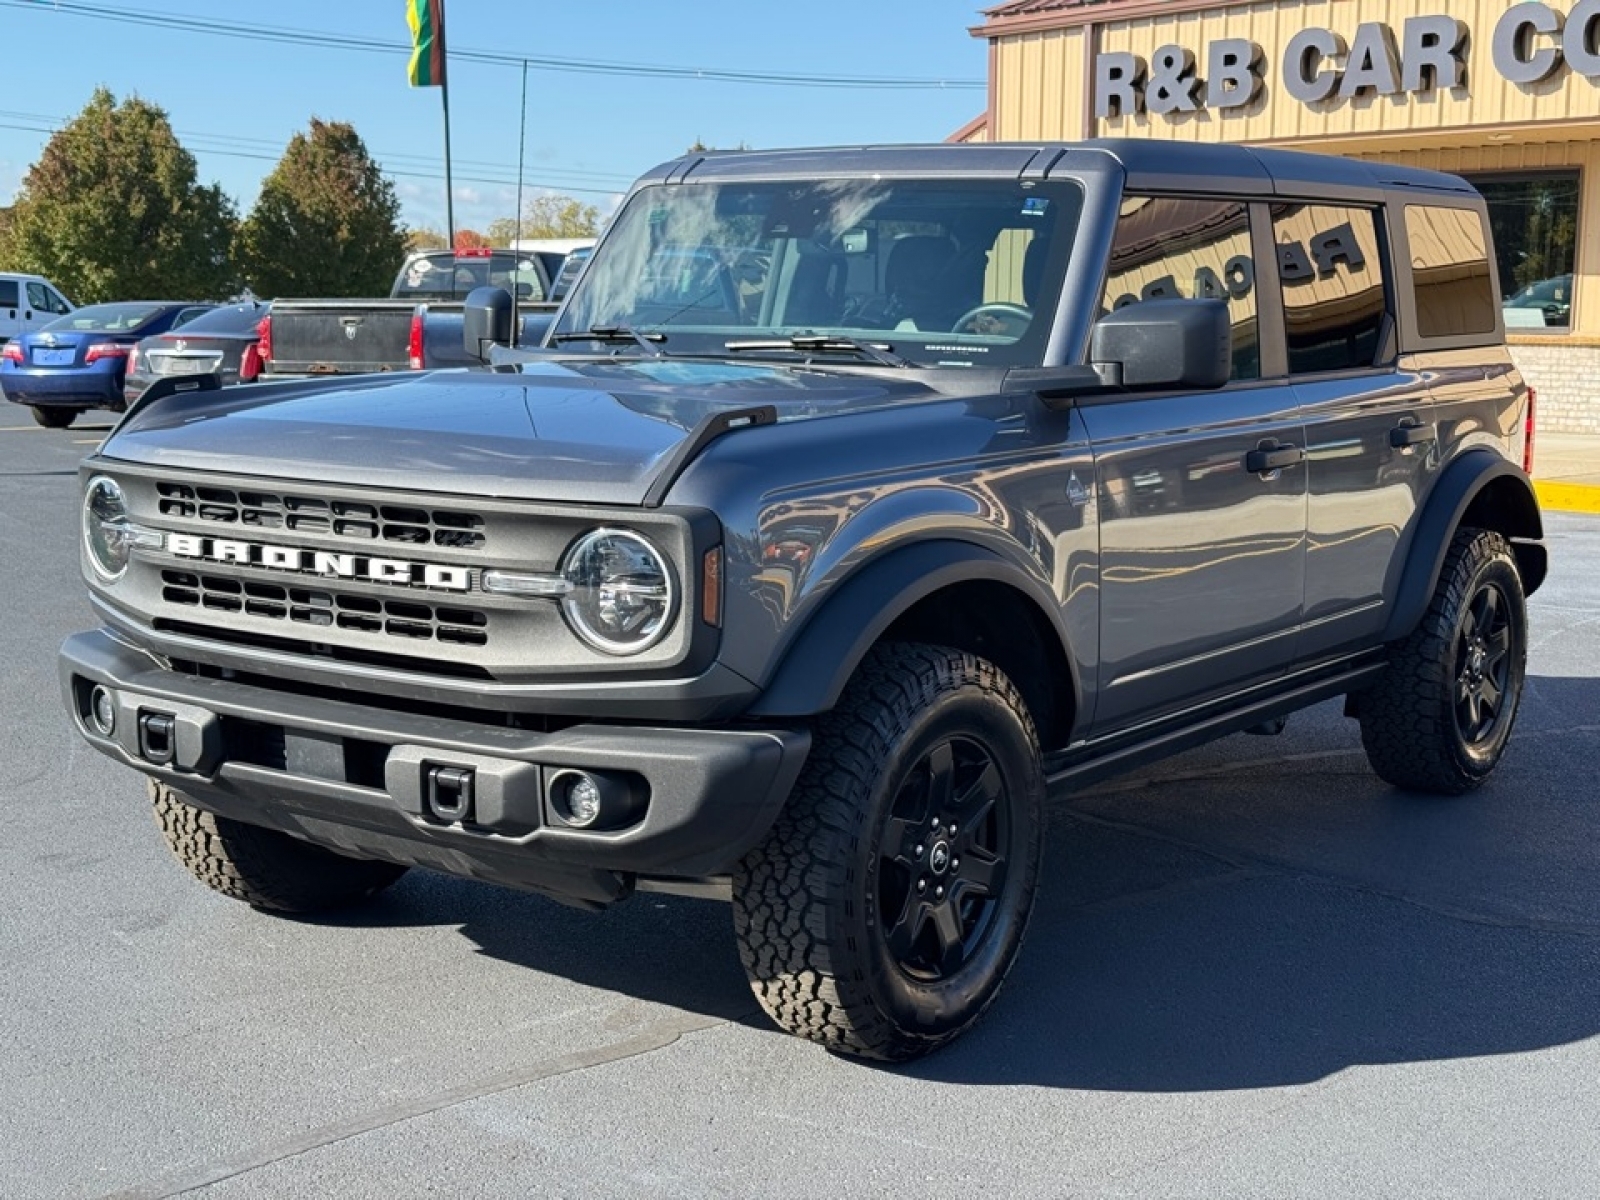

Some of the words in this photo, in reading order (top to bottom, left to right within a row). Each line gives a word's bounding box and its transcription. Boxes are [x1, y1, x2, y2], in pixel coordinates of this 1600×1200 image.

[1095, 38, 1254, 118] R&B
[1283, 15, 1458, 101] CAR
[167, 533, 472, 589] BRONCO
